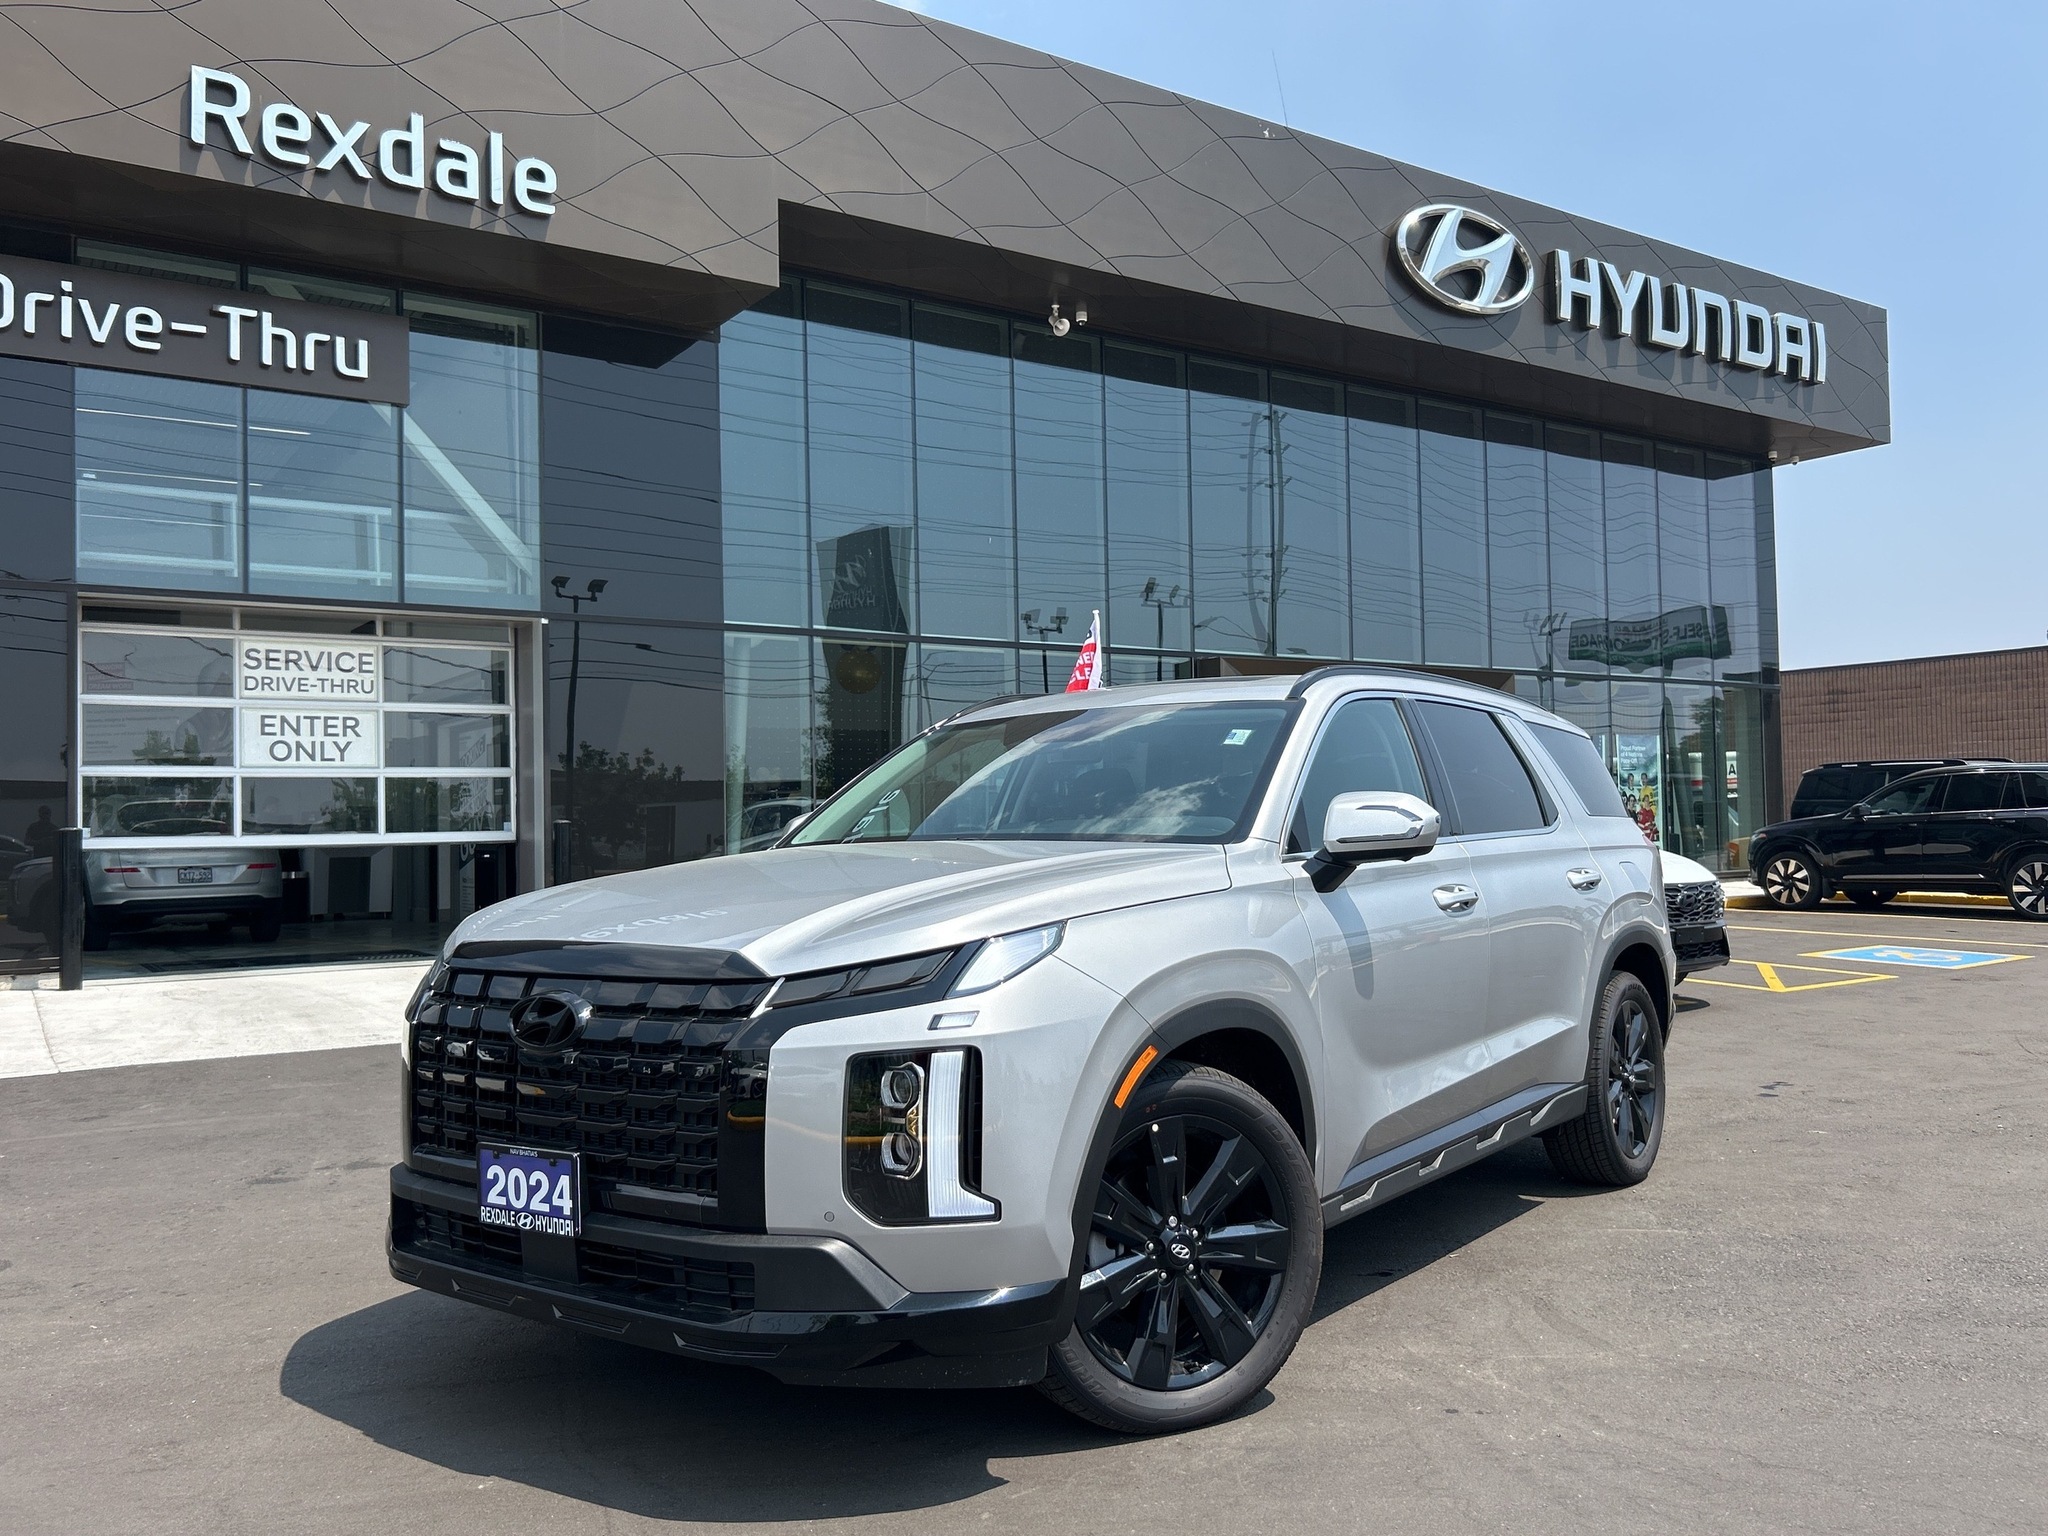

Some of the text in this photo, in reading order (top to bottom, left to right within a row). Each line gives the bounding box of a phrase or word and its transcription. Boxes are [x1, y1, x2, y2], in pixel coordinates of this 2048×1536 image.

[189, 64, 558, 217] Rexdale
[1551, 248, 1827, 385] HYUNDAI
[243, 647, 375, 674] SERVICE
[243, 675, 375, 695] DRIVE-THRU
[259, 714, 362, 738] ENTER
[268, 739, 353, 762] ONLY
[486, 1164, 573, 1216] 2024
[480, 1205, 574, 1237] REXDALE HYUNDAI
